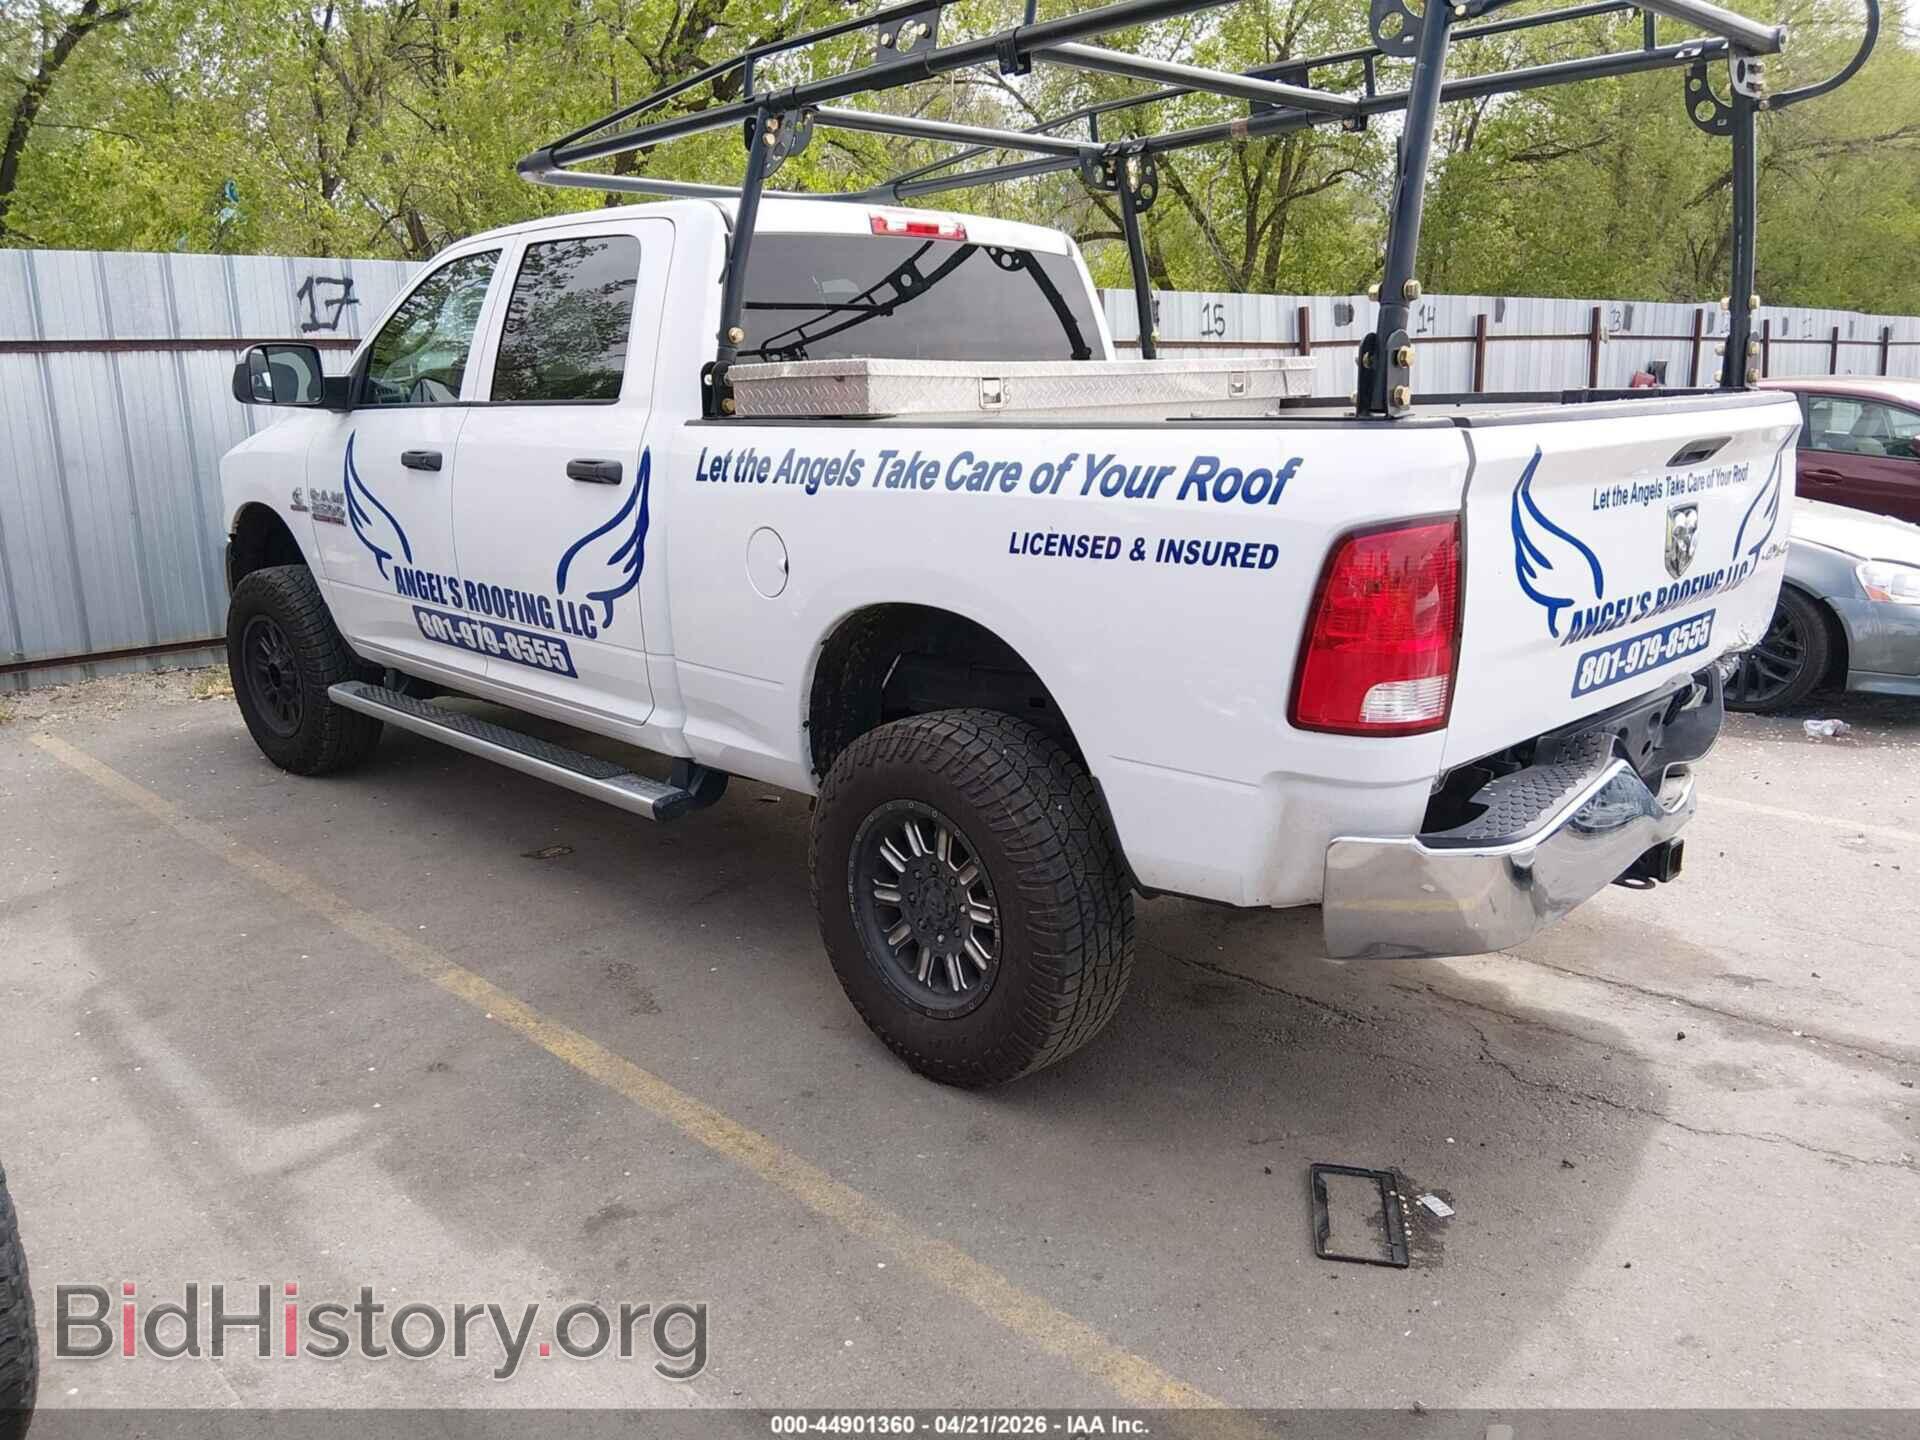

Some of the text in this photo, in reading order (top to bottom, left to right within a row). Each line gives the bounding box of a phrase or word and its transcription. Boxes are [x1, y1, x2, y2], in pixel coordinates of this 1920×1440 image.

[1200, 302, 1226, 336] 15
[1416, 304, 1436, 336] 14
[696, 447, 1304, 505] Let the Angels Take Care of Your Roof
[1593, 463, 1749, 510] Let the Angels Take Care of Your Roof
[1009, 532, 1280, 569] LICENSED & INSURED
[394, 566, 598, 639] ANGEL'S ROOFING LLC
[1560, 591, 1651, 647] ANGEL'S
[418, 611, 569, 672] 801-979-8555
[1579, 615, 1712, 690] 801-979-8555
